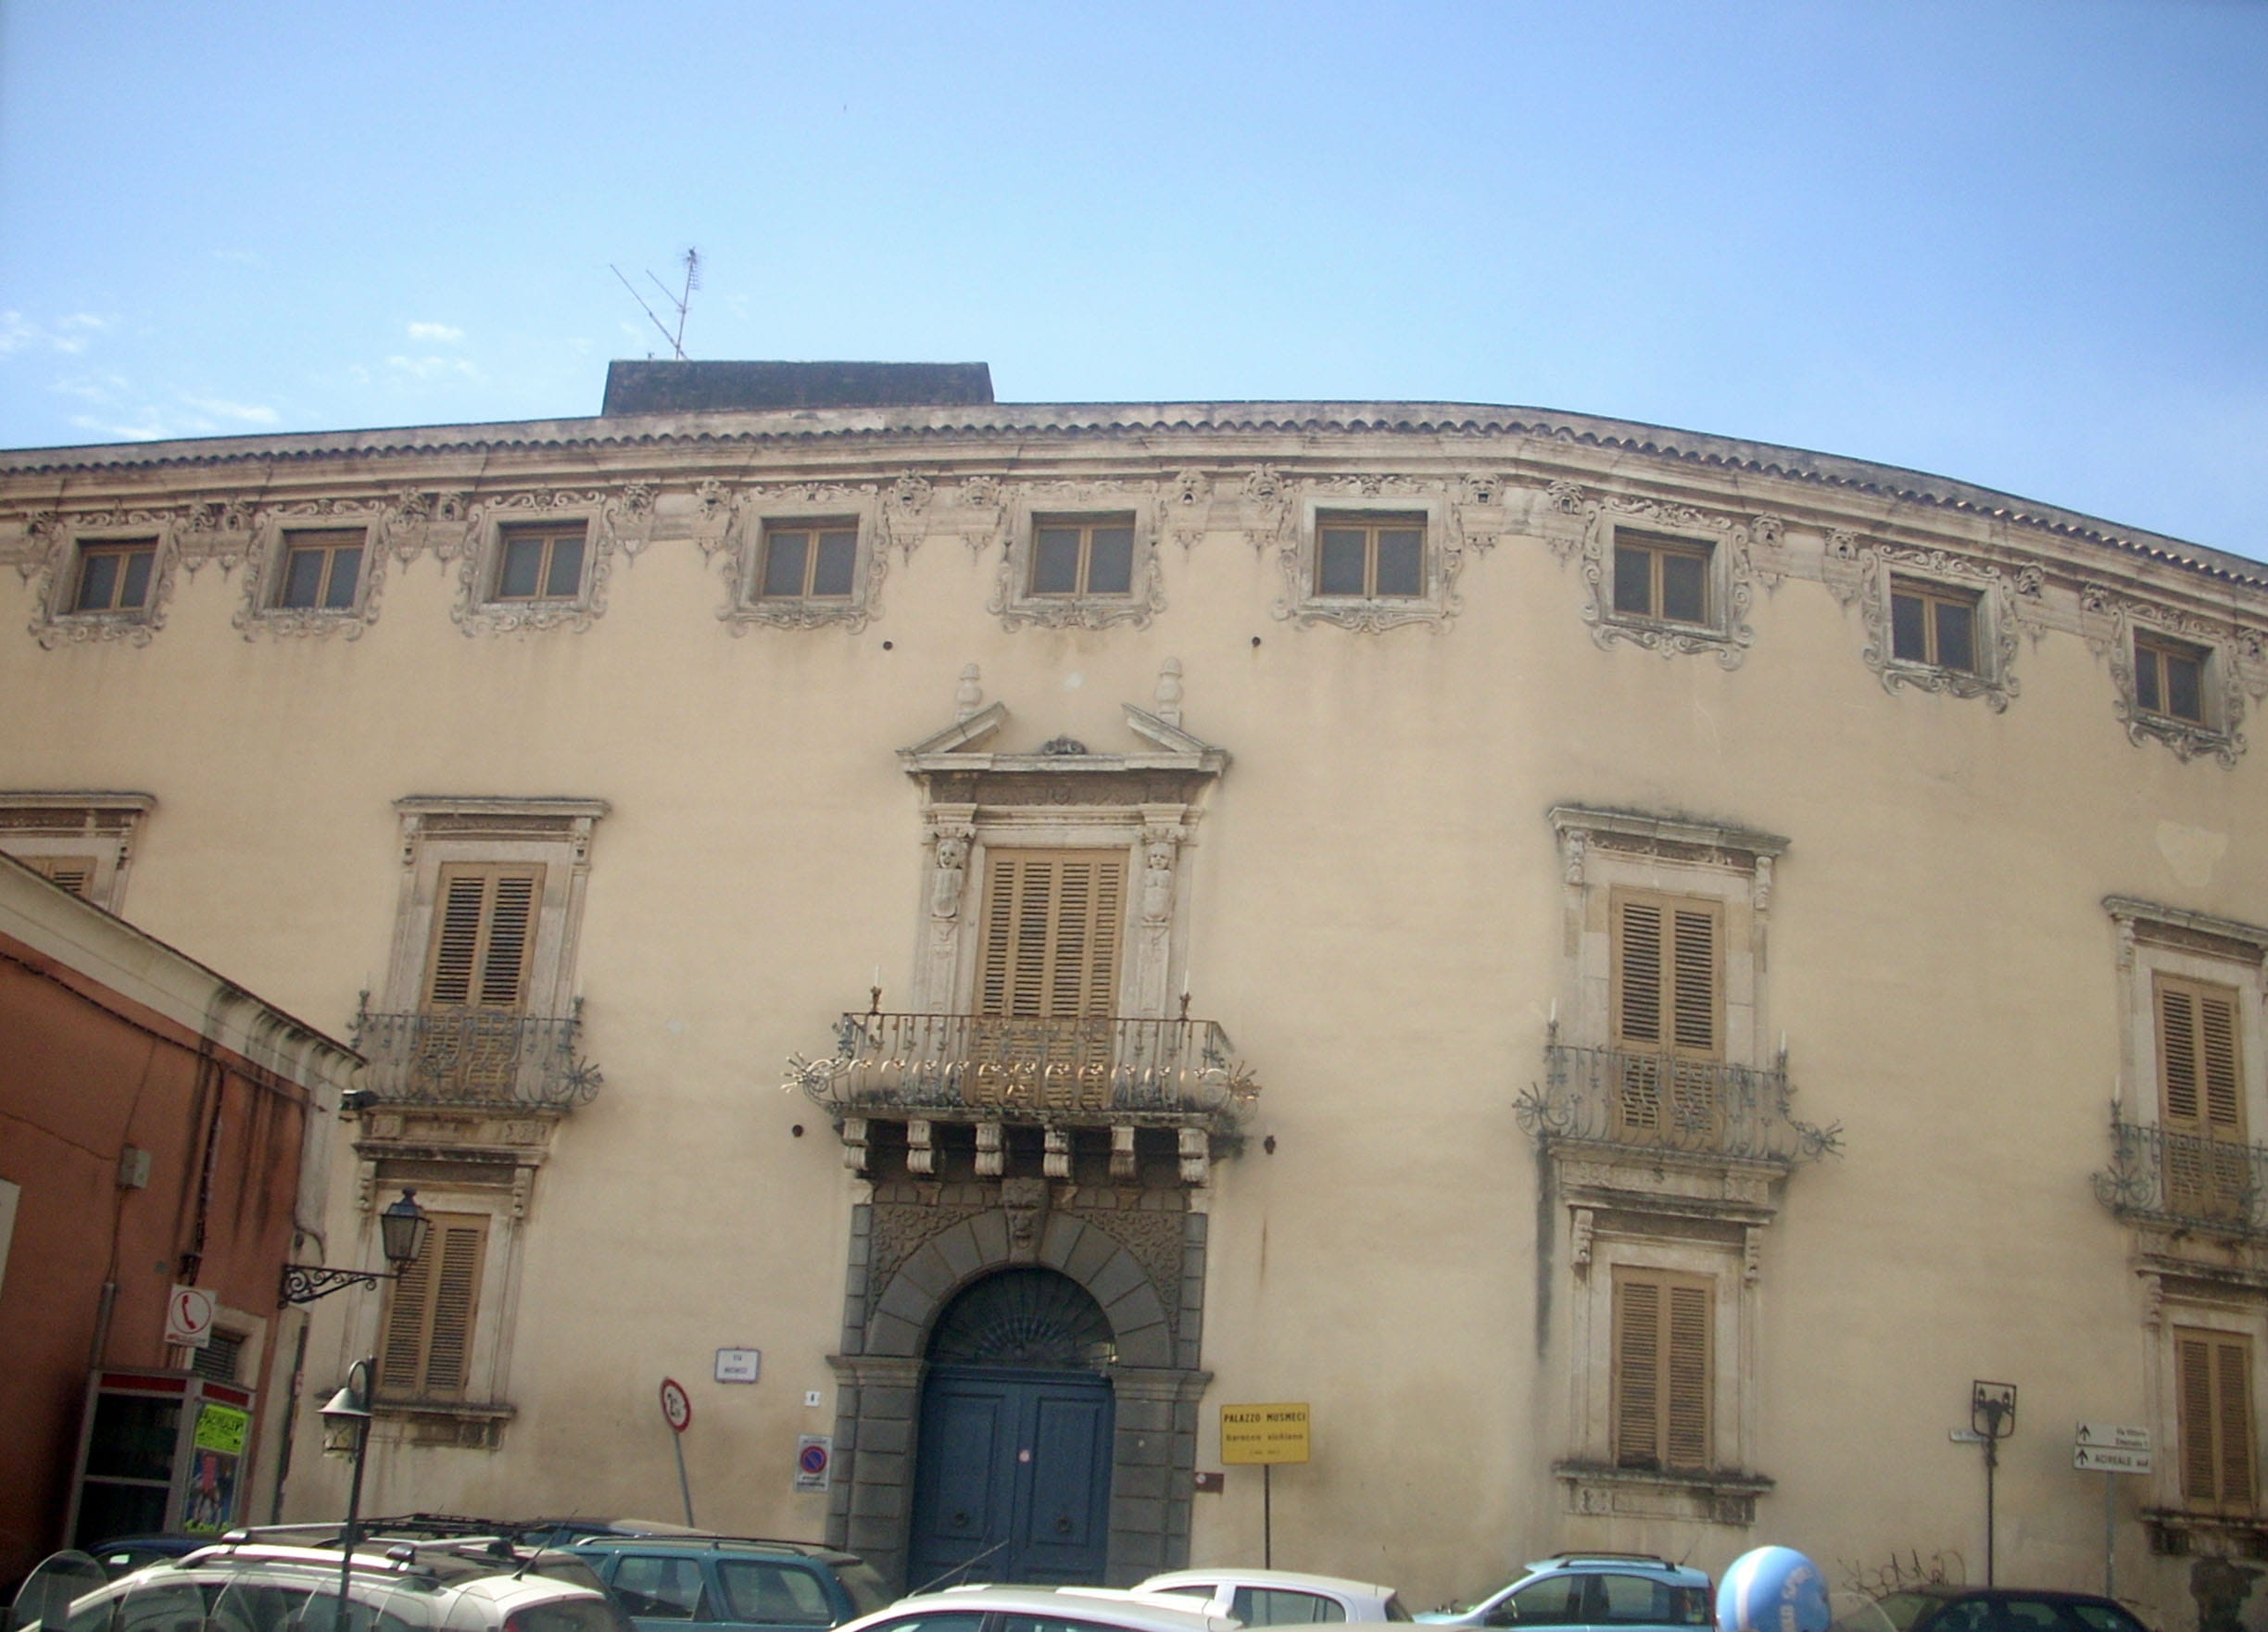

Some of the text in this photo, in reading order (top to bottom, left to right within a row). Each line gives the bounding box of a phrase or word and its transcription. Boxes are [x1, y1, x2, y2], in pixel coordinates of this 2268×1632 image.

[1224, 1412, 1305, 1424] PALAZZO MUSMECI
[2095, 1453, 2132, 1466] ACIREALE
